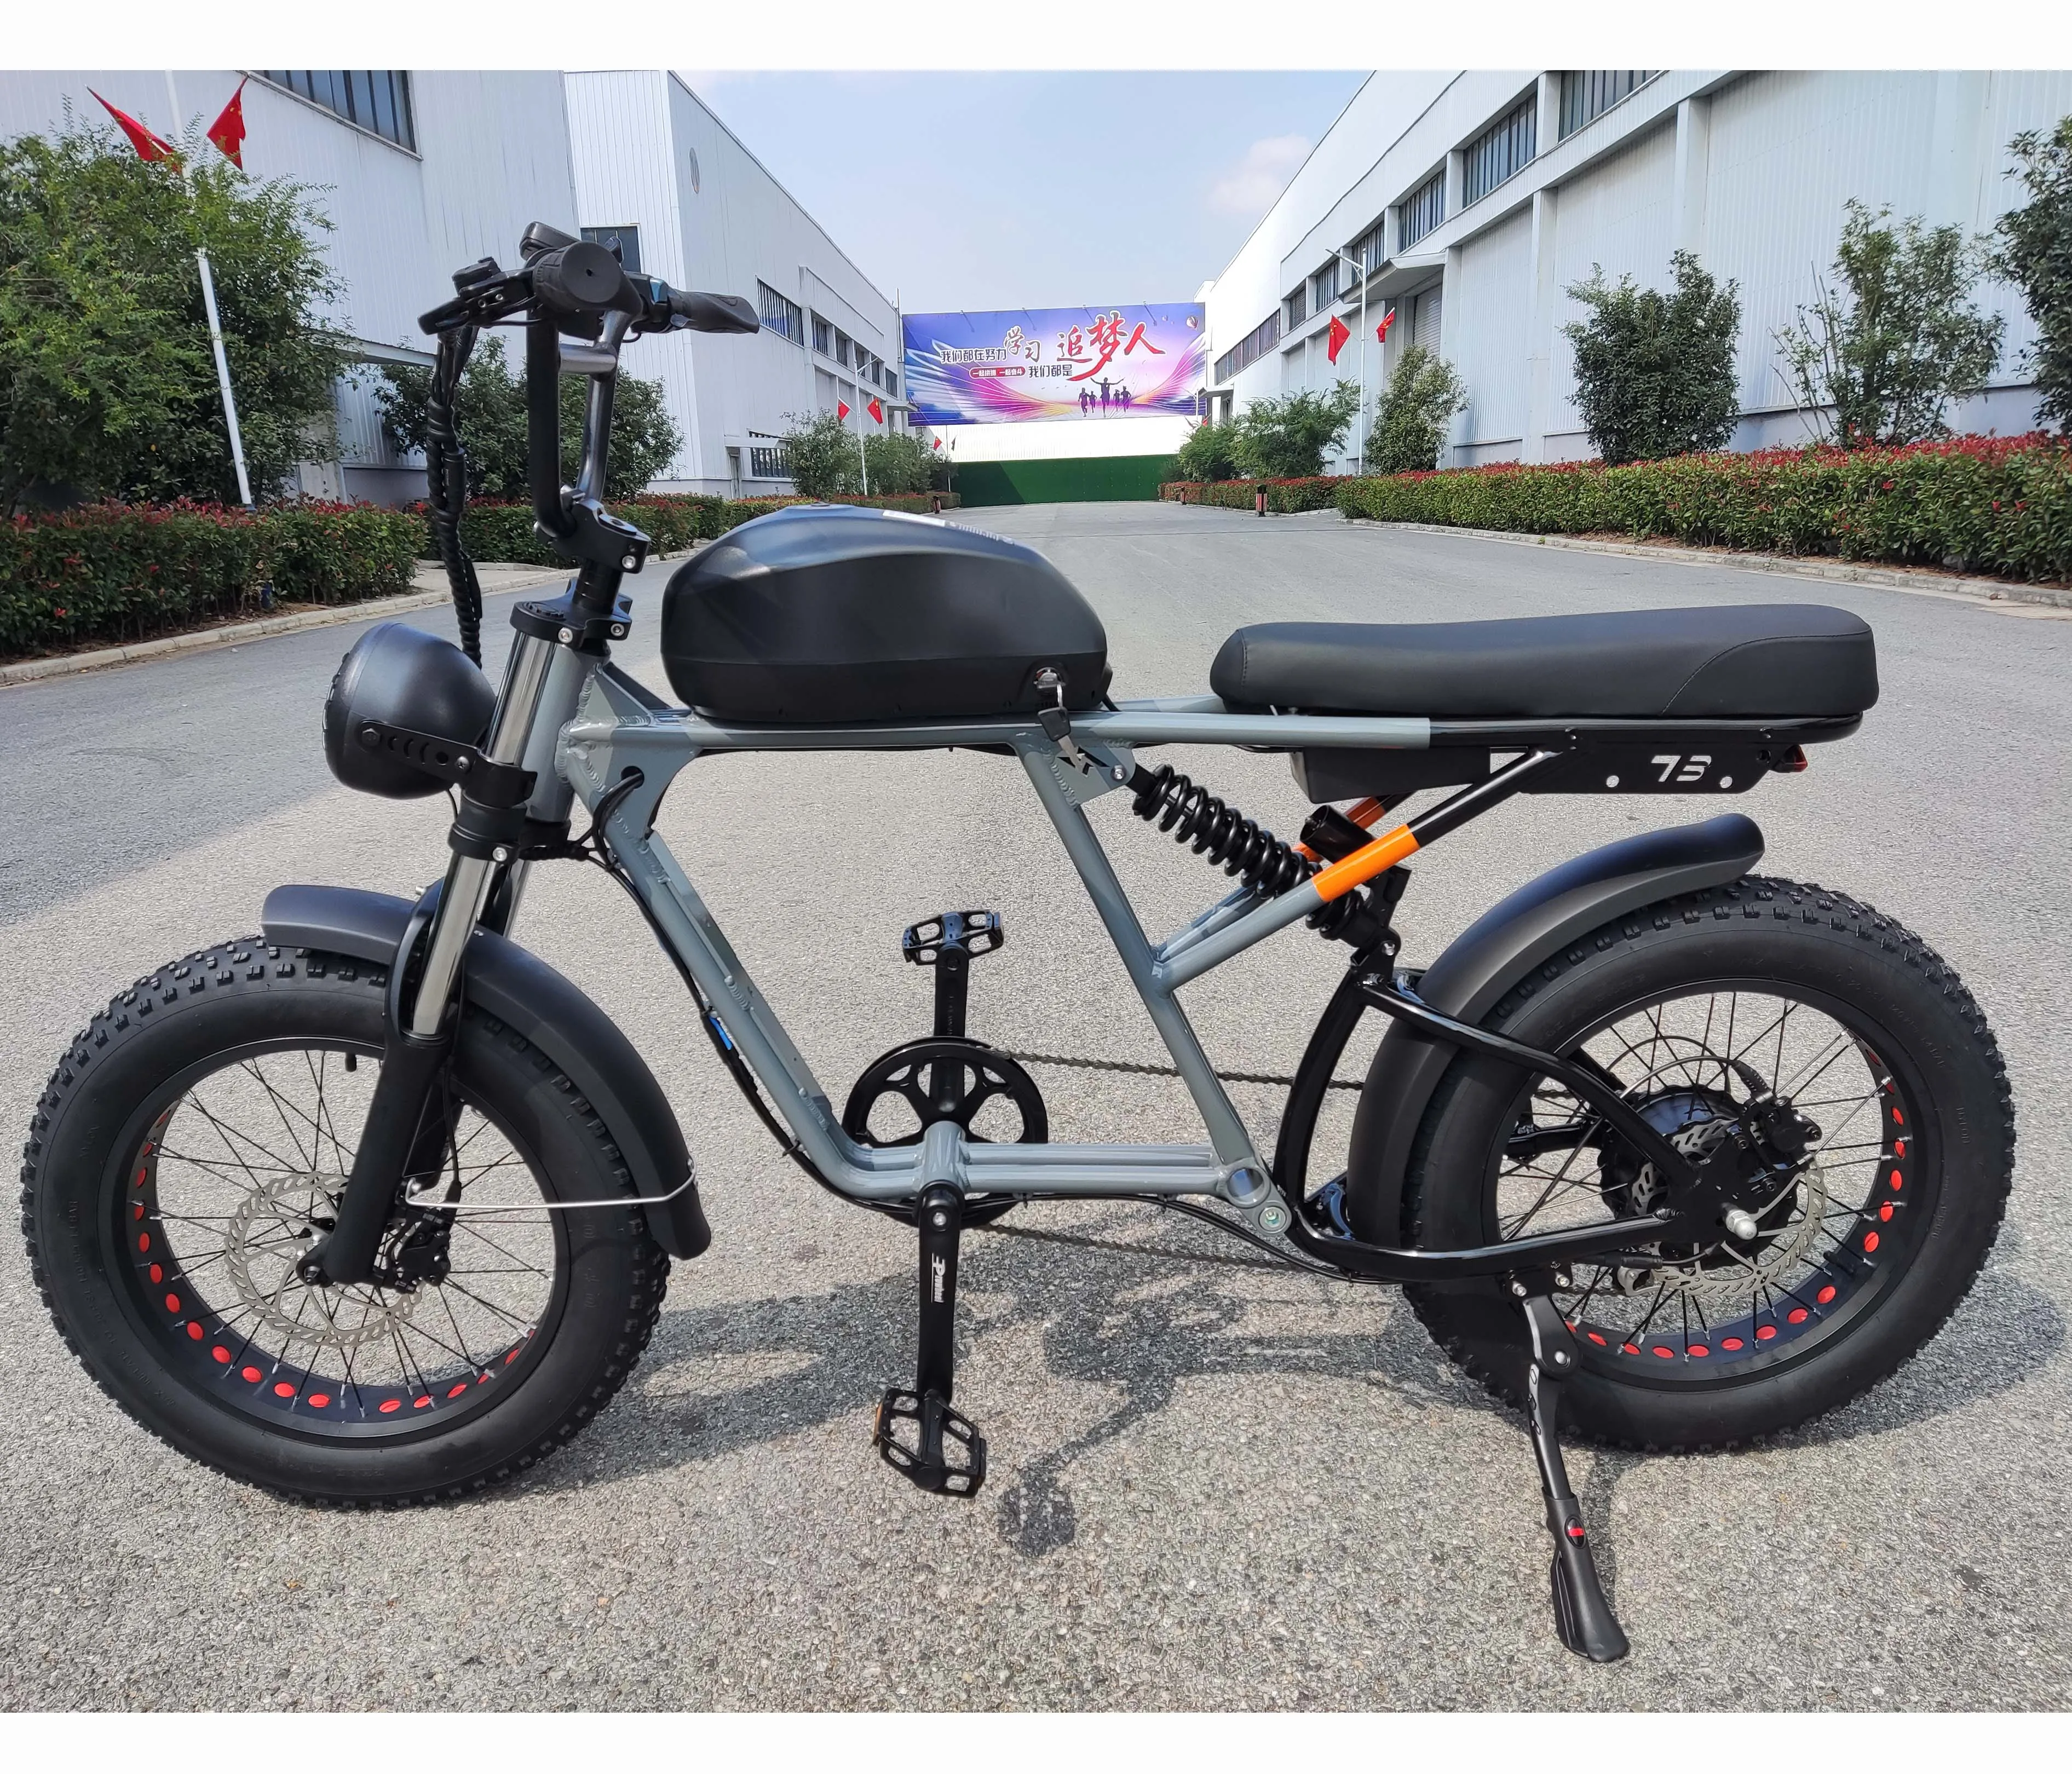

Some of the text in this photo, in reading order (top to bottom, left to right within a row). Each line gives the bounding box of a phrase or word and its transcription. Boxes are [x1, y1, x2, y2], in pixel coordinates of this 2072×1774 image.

[941, 327, 1041, 363] 我们都在努力 学习
[1028, 312, 1166, 381] 我们都是 追梦人
[1651, 755, 1712, 782] 73
